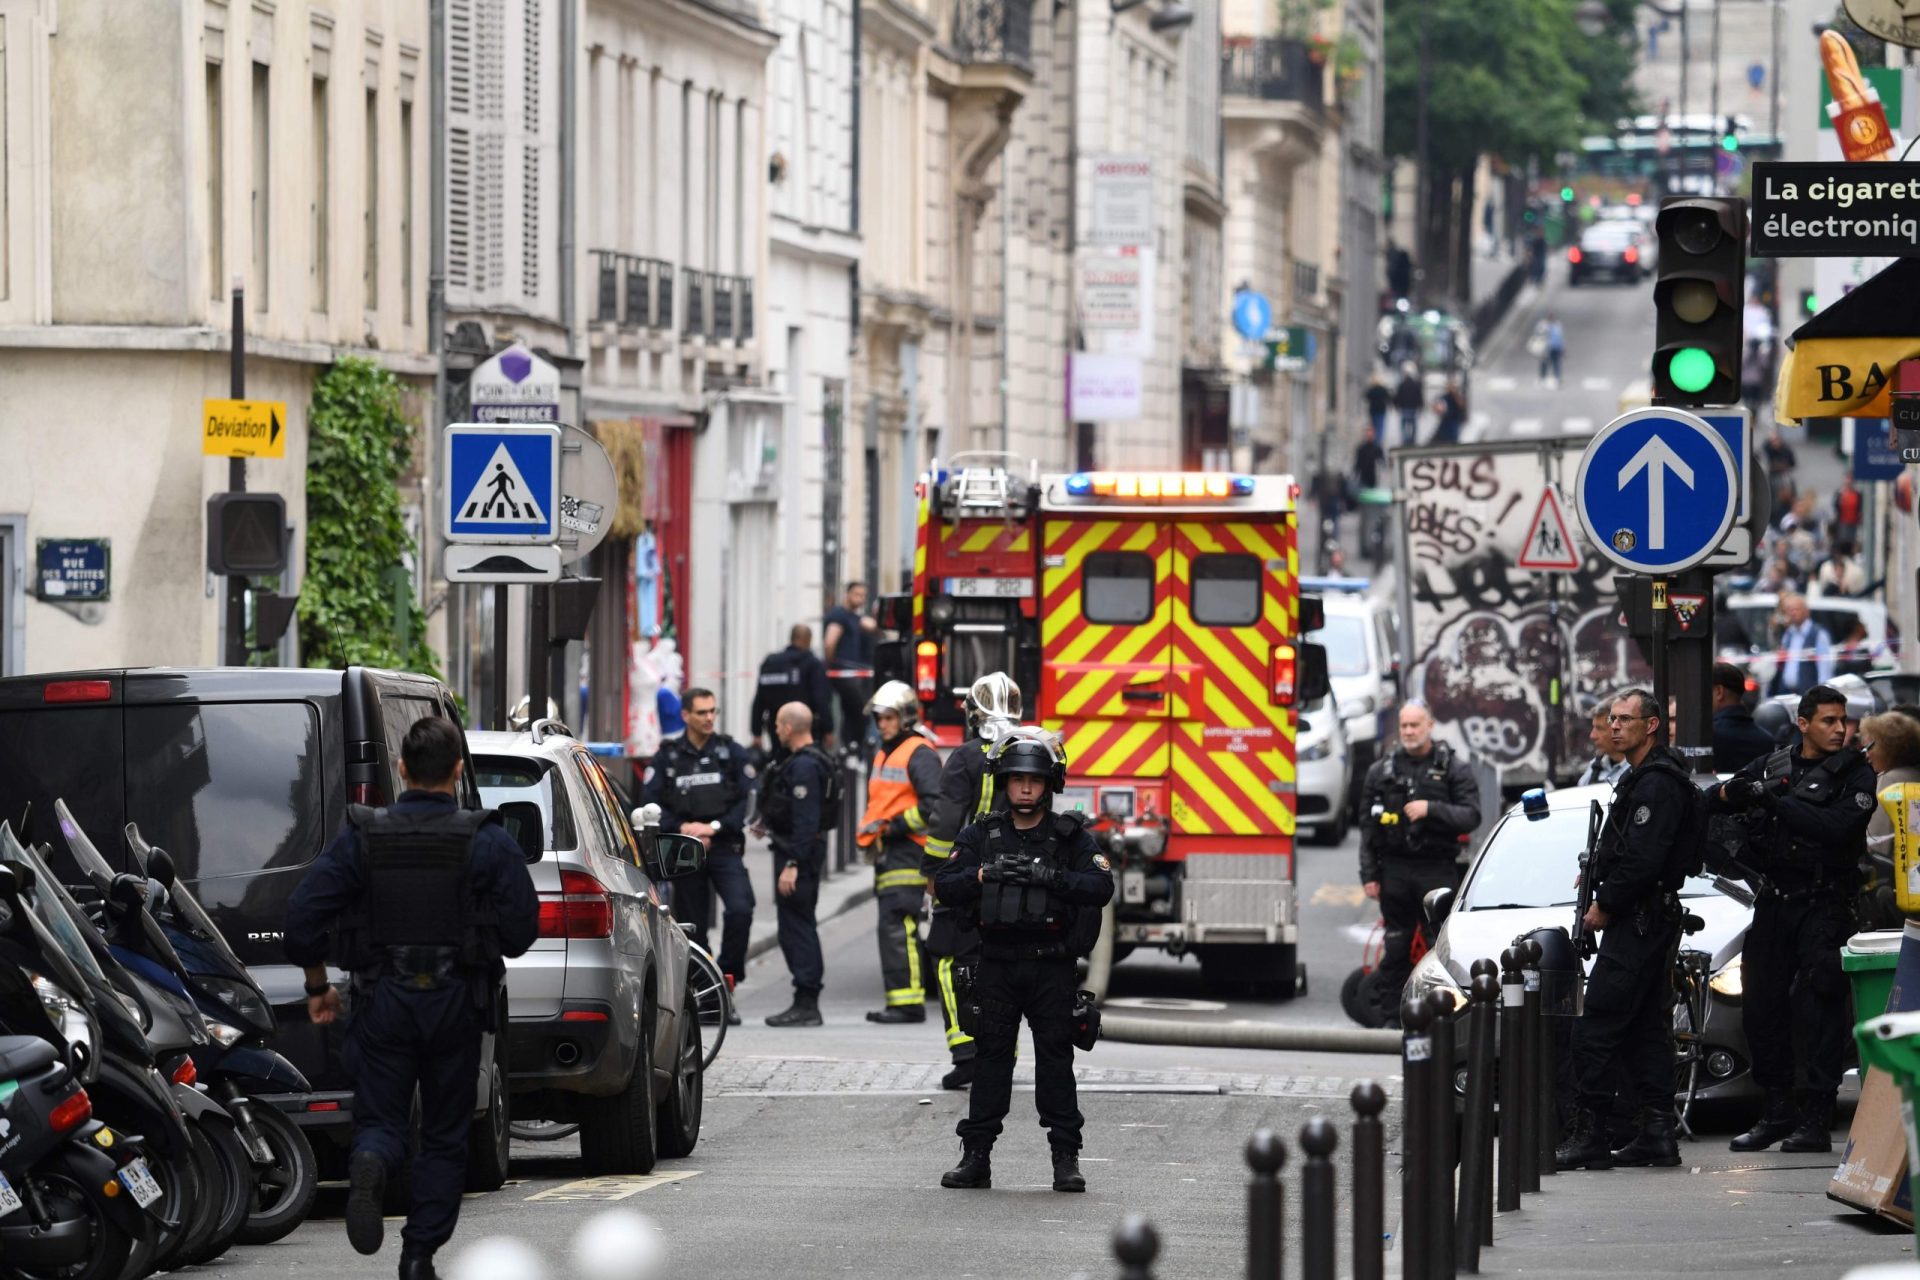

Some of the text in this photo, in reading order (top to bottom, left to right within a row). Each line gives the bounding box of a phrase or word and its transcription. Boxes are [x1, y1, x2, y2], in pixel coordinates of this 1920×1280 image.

[1765, 176, 1920, 208] La cigaret
[1763, 213, 1918, 244] électroniq
[207, 415, 267, 438] Déviation
[63, 558, 84, 569] RUE
[66, 569, 105, 580] PETITES
